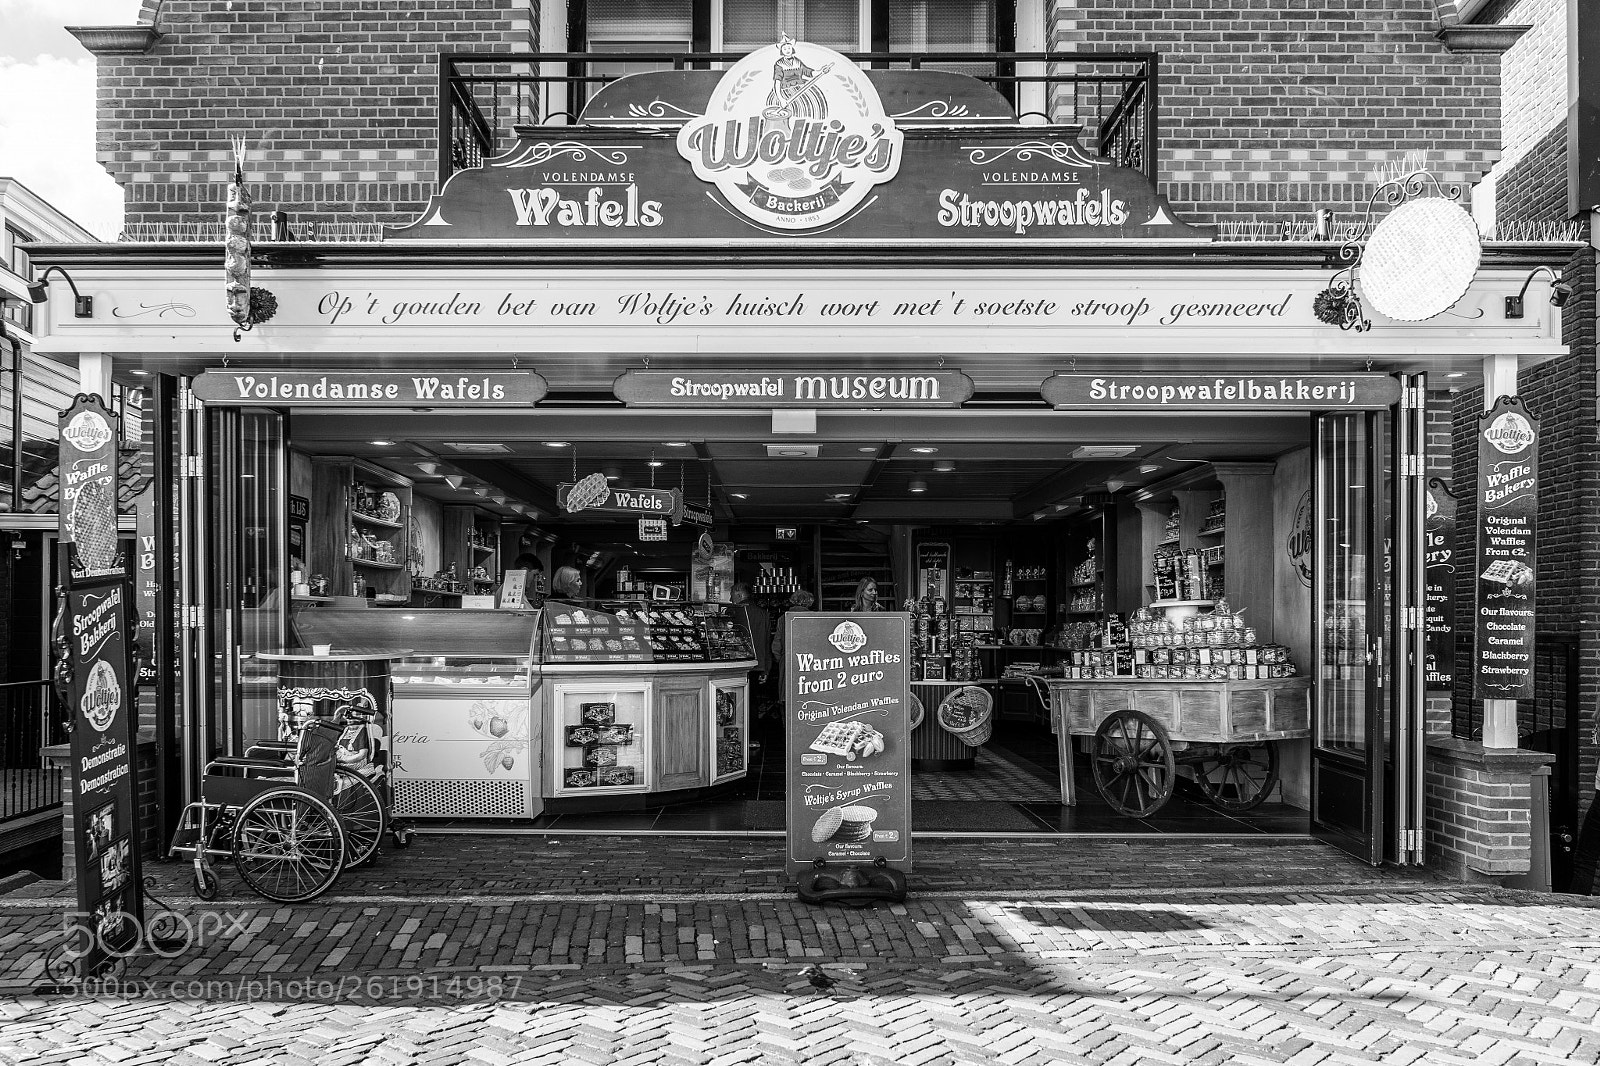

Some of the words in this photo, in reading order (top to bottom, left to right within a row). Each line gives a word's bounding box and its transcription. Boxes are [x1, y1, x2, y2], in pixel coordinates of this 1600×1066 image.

[688, 116, 893, 180] Woltje's
[542, 172, 635, 182] VOLENDAMSE
[982, 172, 1079, 182] VOLENDAMSE
[507, 183, 664, 227] Wafels
[765, 195, 826, 213] Backerij
[937, 188, 1128, 234] Stroopwafels
[775, 215, 796, 224] ANNO
[804, 215, 821, 224] 1853
[318, 291, 355, 324] Op
[364, 292, 381, 315] 't
[382, 292, 484, 324] gouden
[497, 292, 537, 316] bet
[550, 302, 600, 316] van
[618, 292, 718, 324] Woltje's
[725, 293, 808, 316] huisch
[820, 300, 881, 316] wort
[893, 300, 943, 316] met
[973, 297, 1060, 316] soetste
[1071, 297, 1155, 325] stroop
[1160, 294, 1294, 325] gesmeerd
[234, 376, 399, 398] Volendamse
[411, 377, 505, 400] Wafels
[670, 377, 784, 400] Stroopwafel
[794, 376, 940, 400] museum
[1089, 379, 1356, 404] Stroopwafelbakkerij
[1488, 428, 1532, 444] Woltje's
[65, 463, 109, 485] Waffle
[1487, 465, 1531, 488] Waffle
[614, 492, 663, 510] Wafels
[1485, 477, 1535, 503] Bakery
[1485, 527, 1532, 536] Volendam
[1487, 516, 1527, 527] Original
[1485, 548, 1509, 556] From
[1490, 537, 1526, 546] Waffles
[73, 588, 121, 636] Stroopwafel
[1481, 608, 1498, 616] Our
[1499, 607, 1535, 617] flavours:
[80, 613, 116, 656] Bakkerij
[1486, 622, 1526, 631] Chocolate
[1488, 637, 1524, 645] Caramel
[796, 653, 843, 672] Warm
[848, 650, 901, 667] waffles
[1482, 651, 1529, 661] Blackberry
[1481, 665, 1529, 676] Strawberry
[798, 676, 834, 695] from
[837, 671, 847, 689] 2
[851, 670, 884, 685] euro
[797, 708, 829, 721] Original
[831, 702, 869, 716] Volendam
[870, 696, 899, 707] Waffles
[81, 743, 126, 773] Demonstratie
[80, 763, 129, 795] Demonstration
[804, 792, 835, 806] Woltje's
[836, 787, 861, 800] Syrup
[862, 781, 893, 793] Waffles
